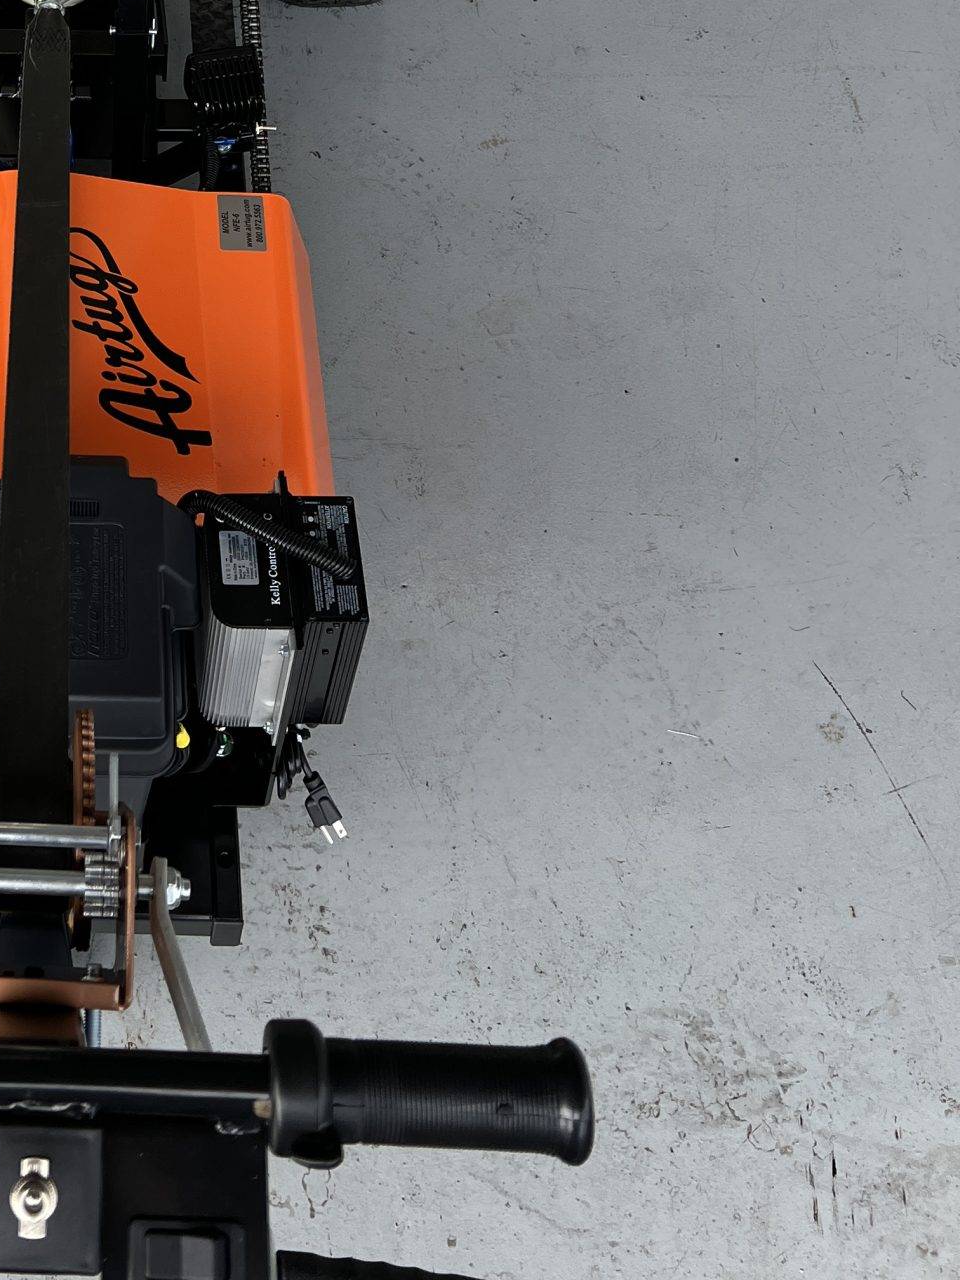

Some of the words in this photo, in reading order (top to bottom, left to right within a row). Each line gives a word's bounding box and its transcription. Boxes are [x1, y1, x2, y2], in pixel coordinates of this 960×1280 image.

[221, 210, 230, 234] MODEL
[70, 227, 213, 455] Airtug
[268, 545, 279, 578] Contro
[269, 579, 282, 606] Kelly
